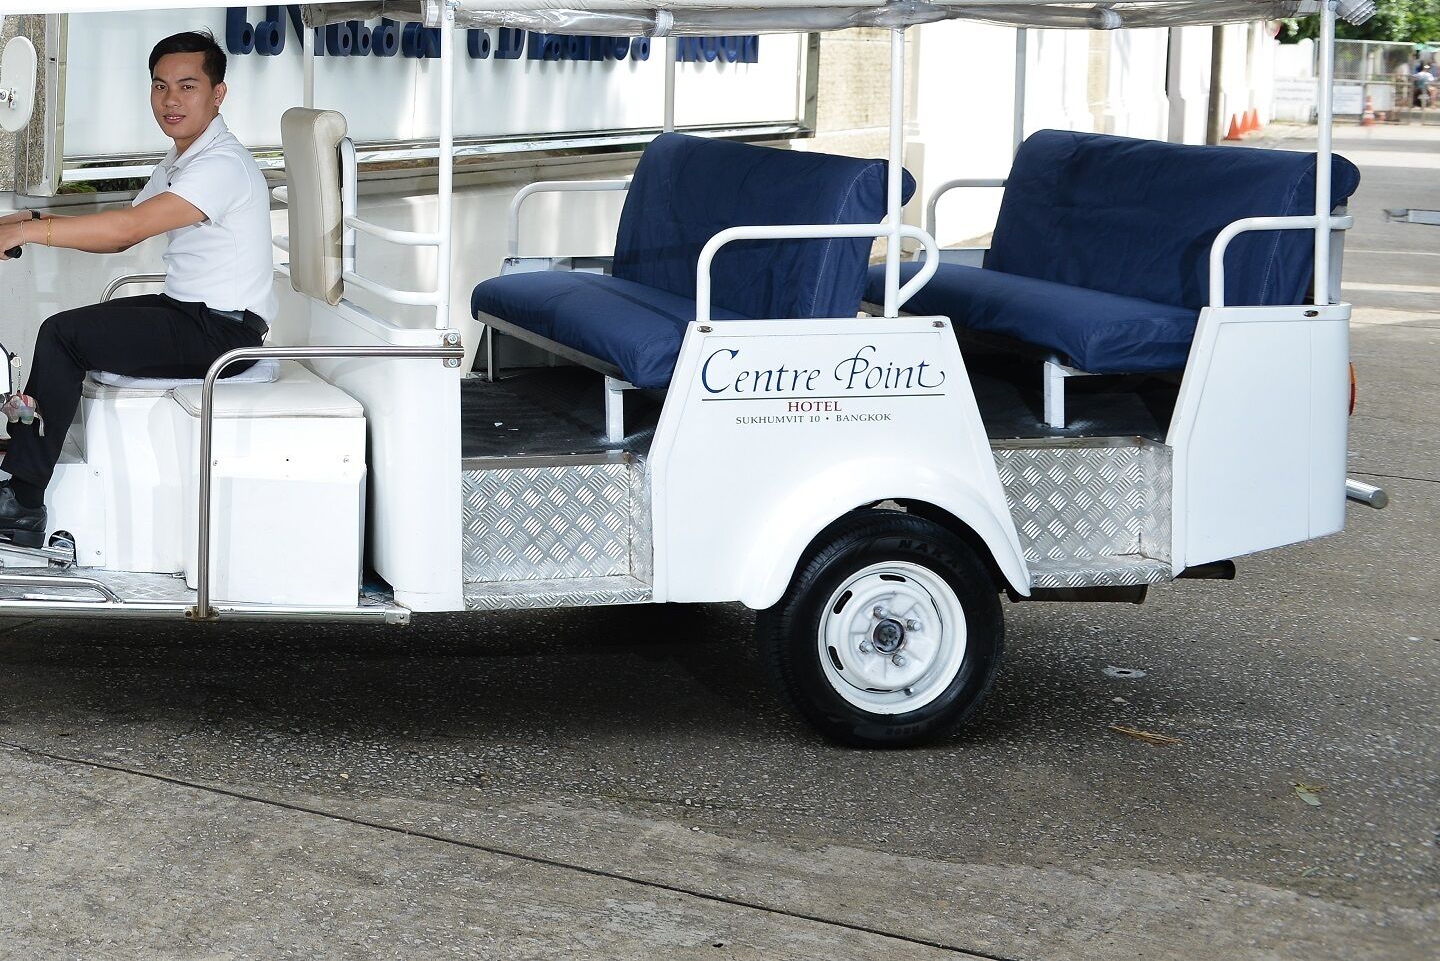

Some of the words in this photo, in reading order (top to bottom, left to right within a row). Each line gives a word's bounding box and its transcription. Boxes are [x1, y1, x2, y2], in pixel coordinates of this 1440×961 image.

[701, 348, 821, 394] Centre
[834, 344, 947, 390] Point
[787, 400, 842, 413] HOTEL
[735, 415, 804, 425] SUKHUMVIT
[808, 415, 821, 423] 10
[835, 413, 892, 423] BANGKOK
